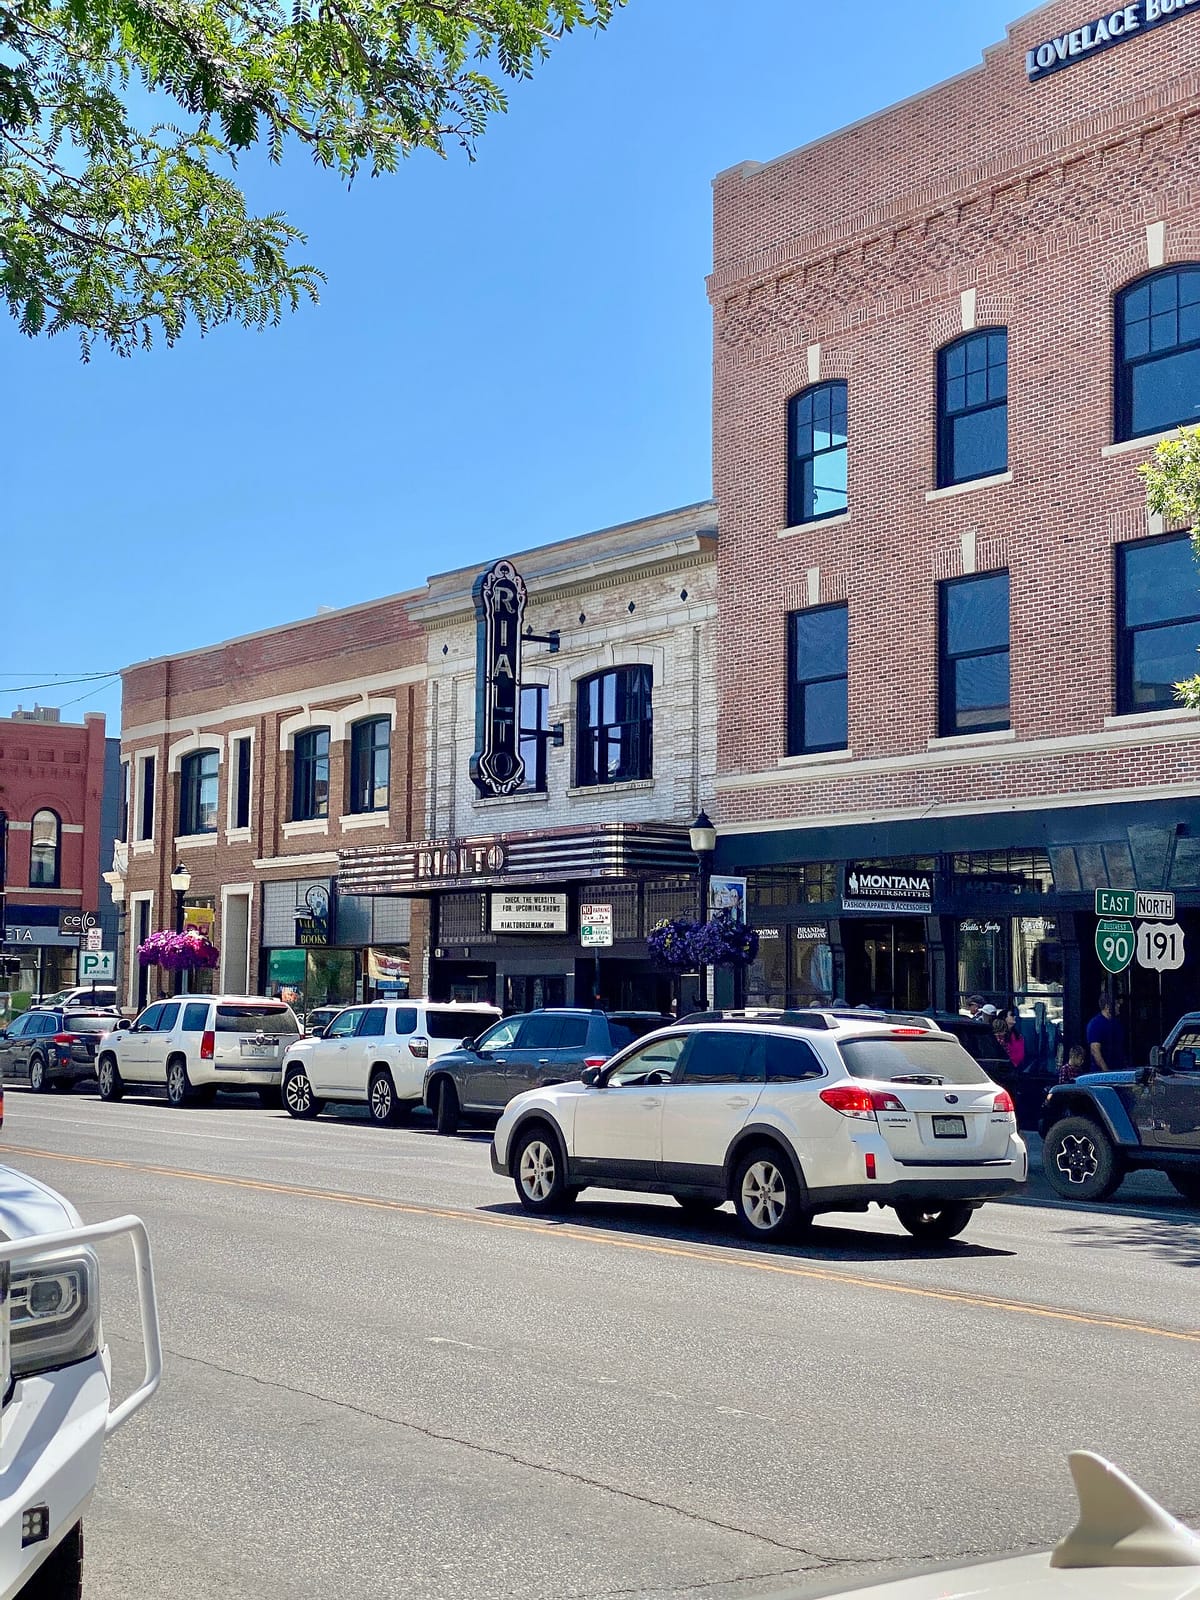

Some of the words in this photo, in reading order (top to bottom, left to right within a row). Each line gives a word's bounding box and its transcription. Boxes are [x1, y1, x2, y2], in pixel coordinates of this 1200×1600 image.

[1025, 4, 1140, 74] LOVELACE
[493, 586, 515, 777] RIALTO
[418, 846, 504, 877] RIALTO
[860, 874, 930, 889] MONTANA
[860, 889, 930, 898] SILVERSMITHS
[1102, 893, 1130, 912] EAST
[582, 906, 592, 914] NO
[1138, 896, 1172, 914] NORTH
[64, 912, 96, 933] cello
[300, 935, 326, 944] BOOKS
[752, 929, 779, 937] ONTANA
[1103, 937, 1128, 961] 90
[1145, 932, 1176, 961] 191
